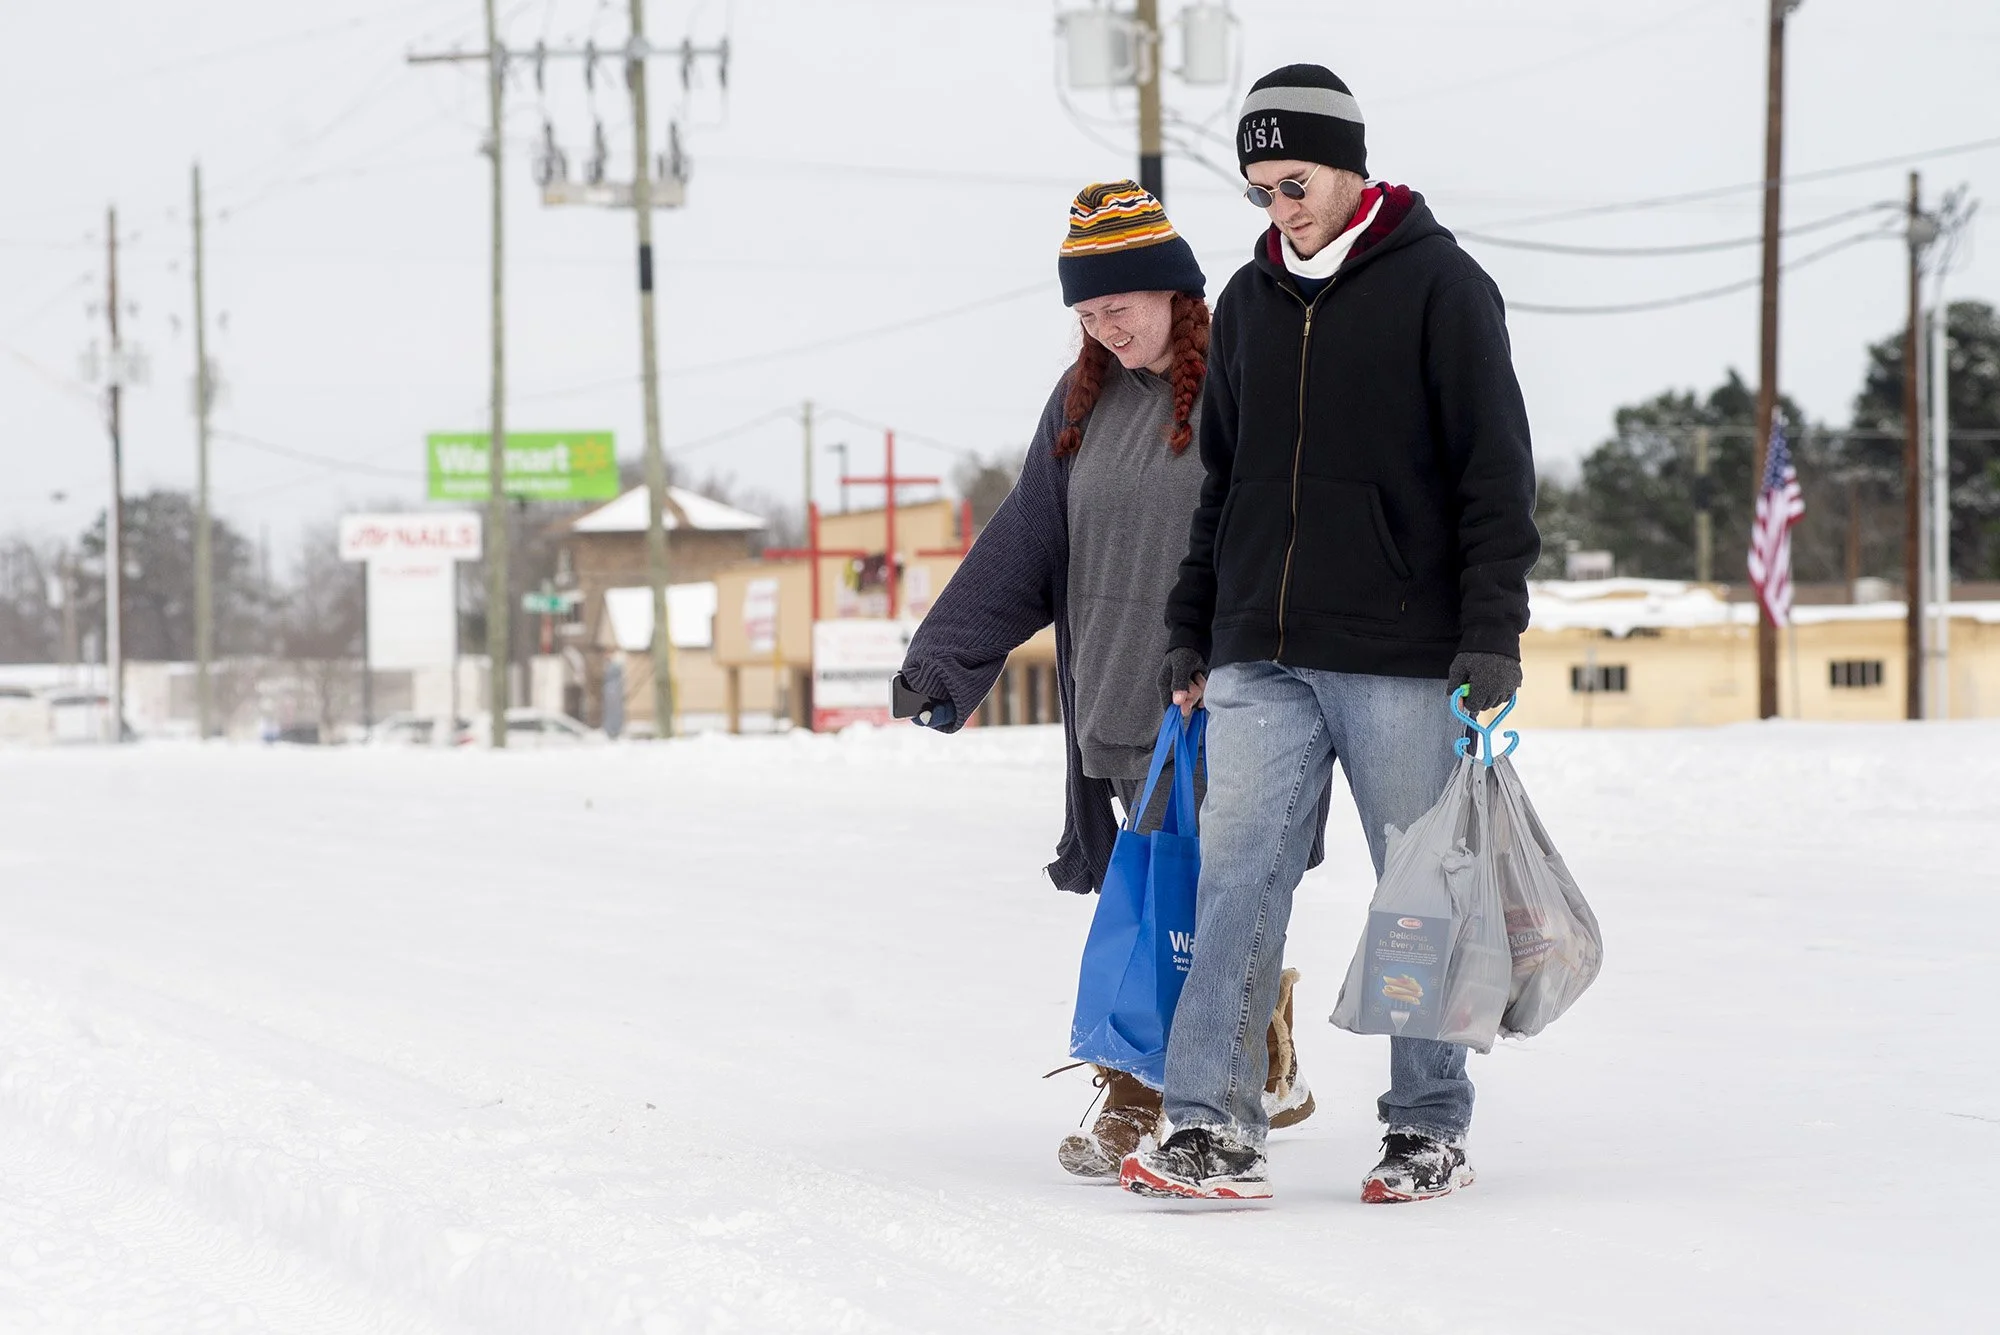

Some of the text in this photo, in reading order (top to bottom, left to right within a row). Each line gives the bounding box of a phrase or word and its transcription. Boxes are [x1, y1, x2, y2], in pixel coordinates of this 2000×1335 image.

[1245, 117, 1277, 130] TEAM
[1243, 127, 1284, 153] USA
[435, 441, 570, 474] Wamart
[1389, 930, 1428, 942] Delicious
[1391, 940, 1415, 951] Every
[1173, 955, 1189, 964] Save
